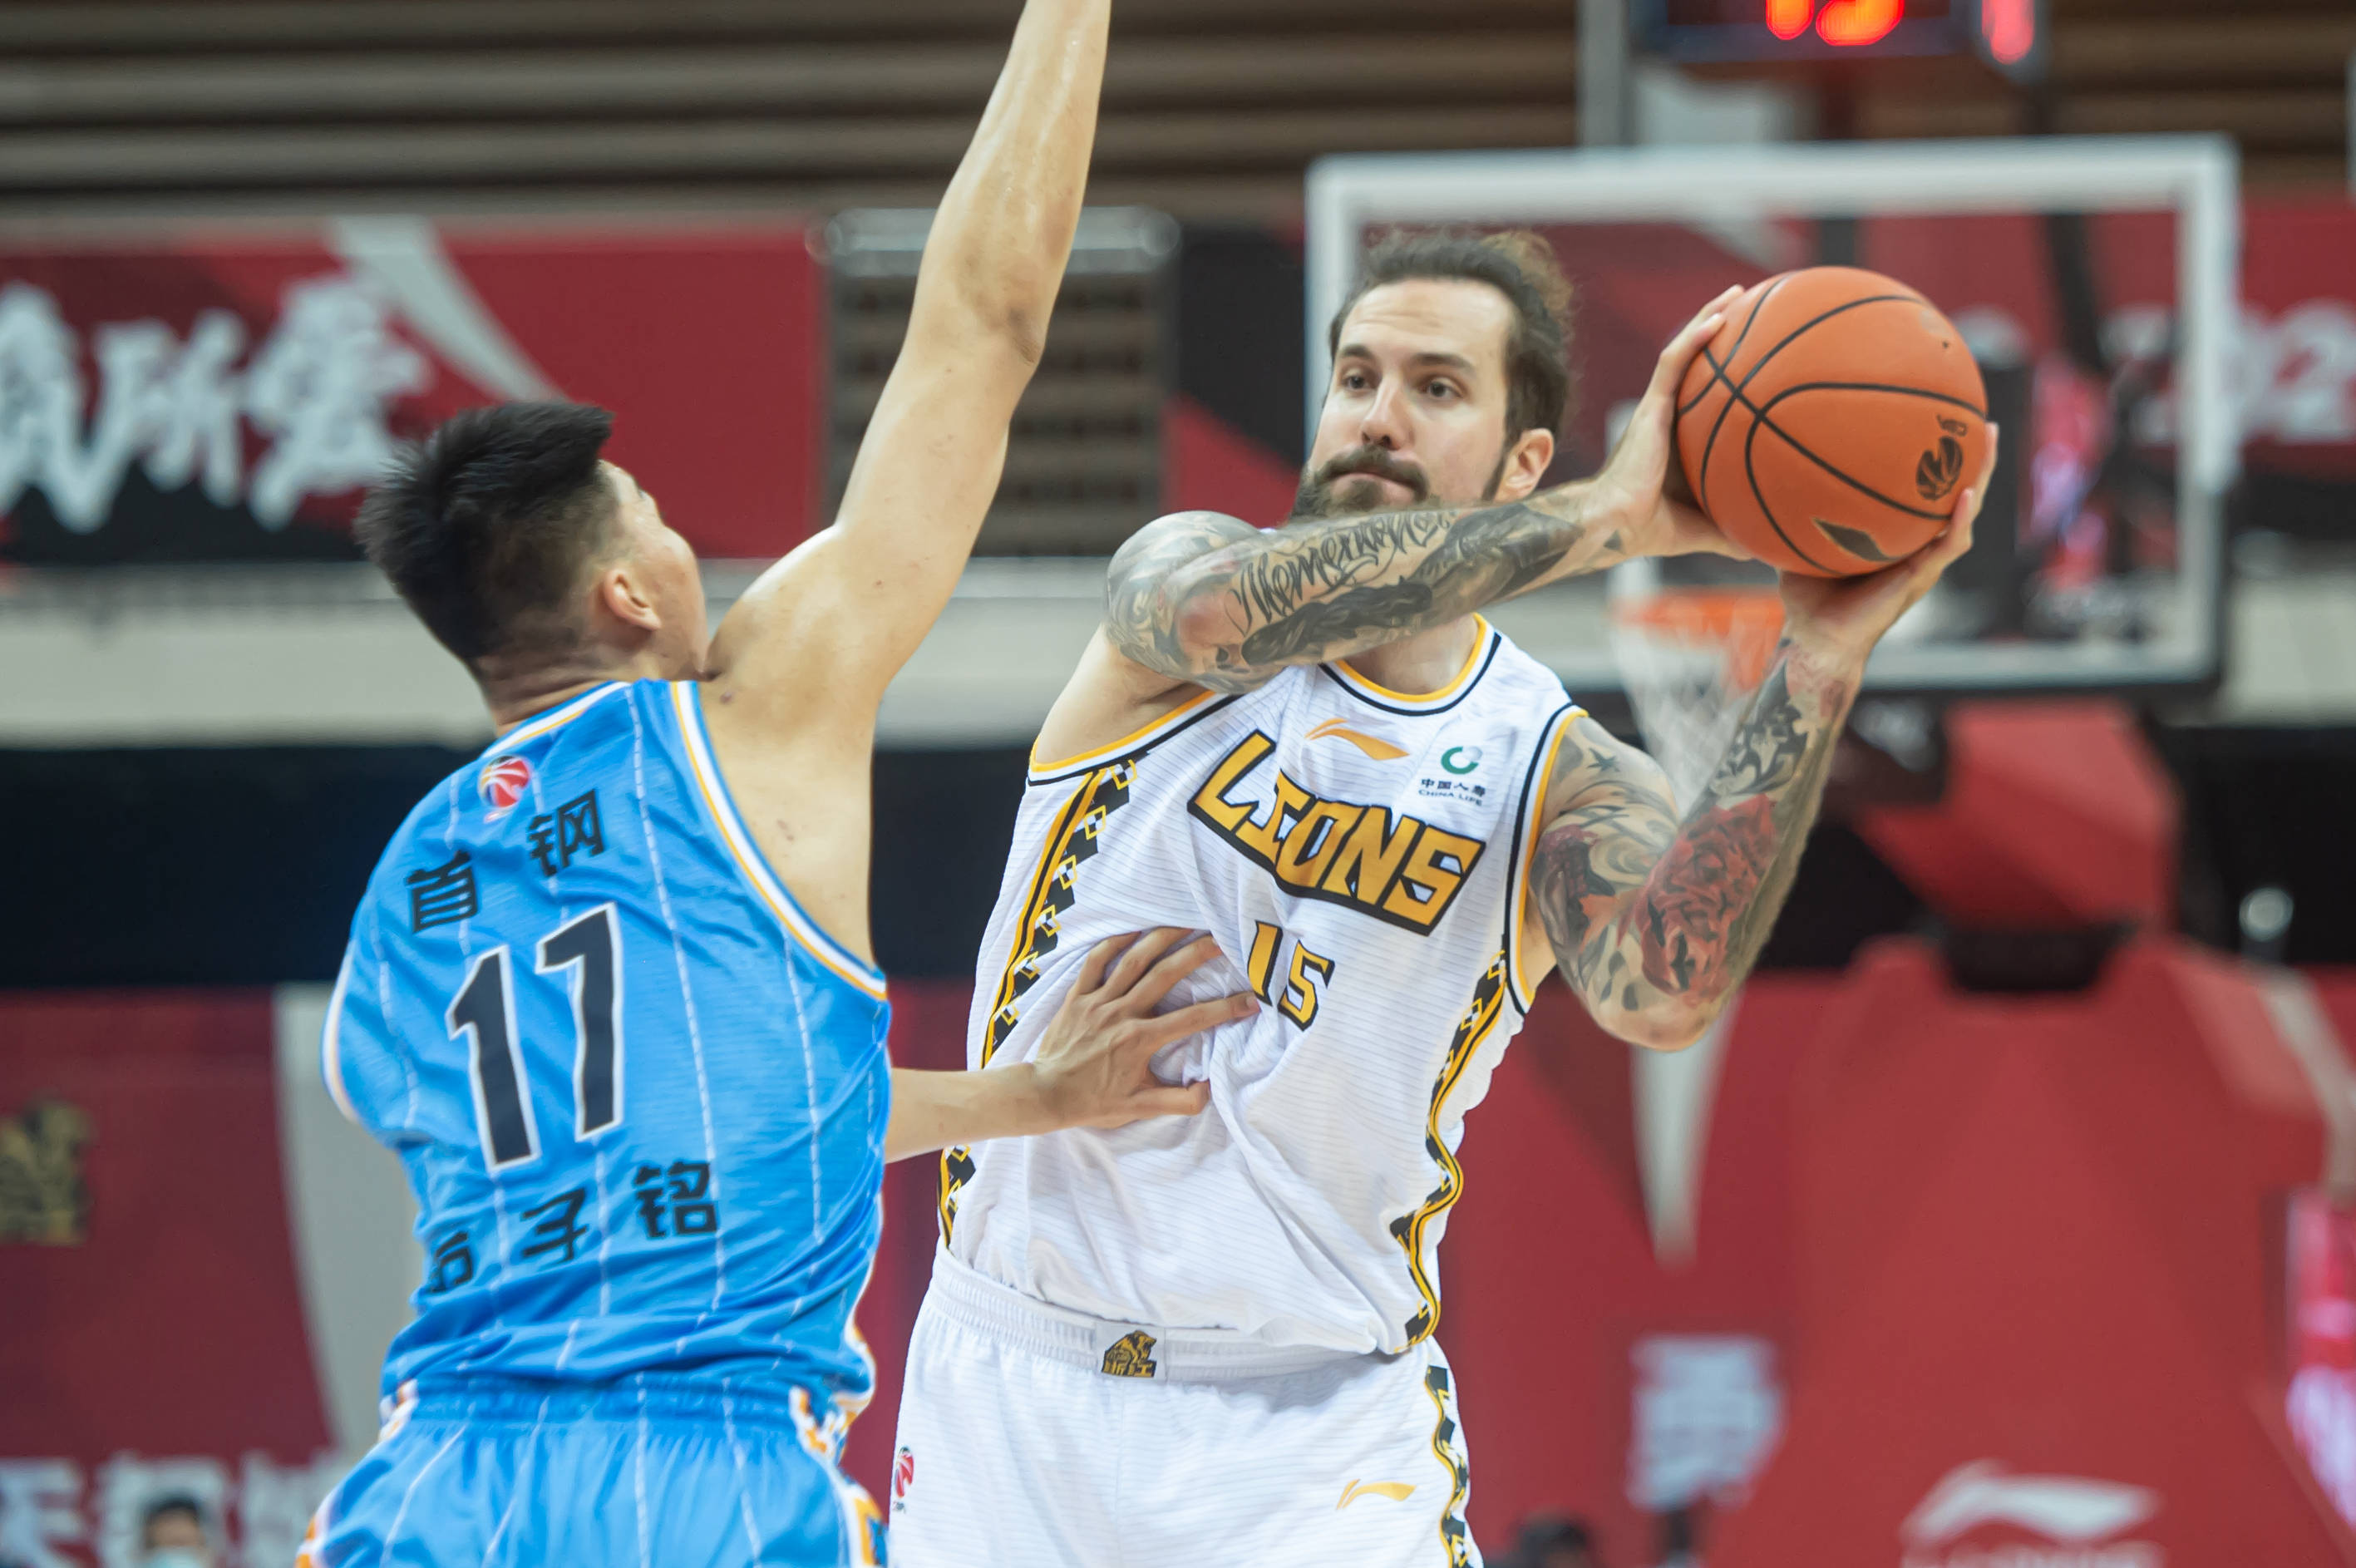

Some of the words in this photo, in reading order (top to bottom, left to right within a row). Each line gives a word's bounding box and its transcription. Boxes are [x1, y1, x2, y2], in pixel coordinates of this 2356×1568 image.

[404, 788, 606, 935] 首钢
[1187, 728, 1486, 937] LIONS
[1247, 920, 1335, 1032] 15
